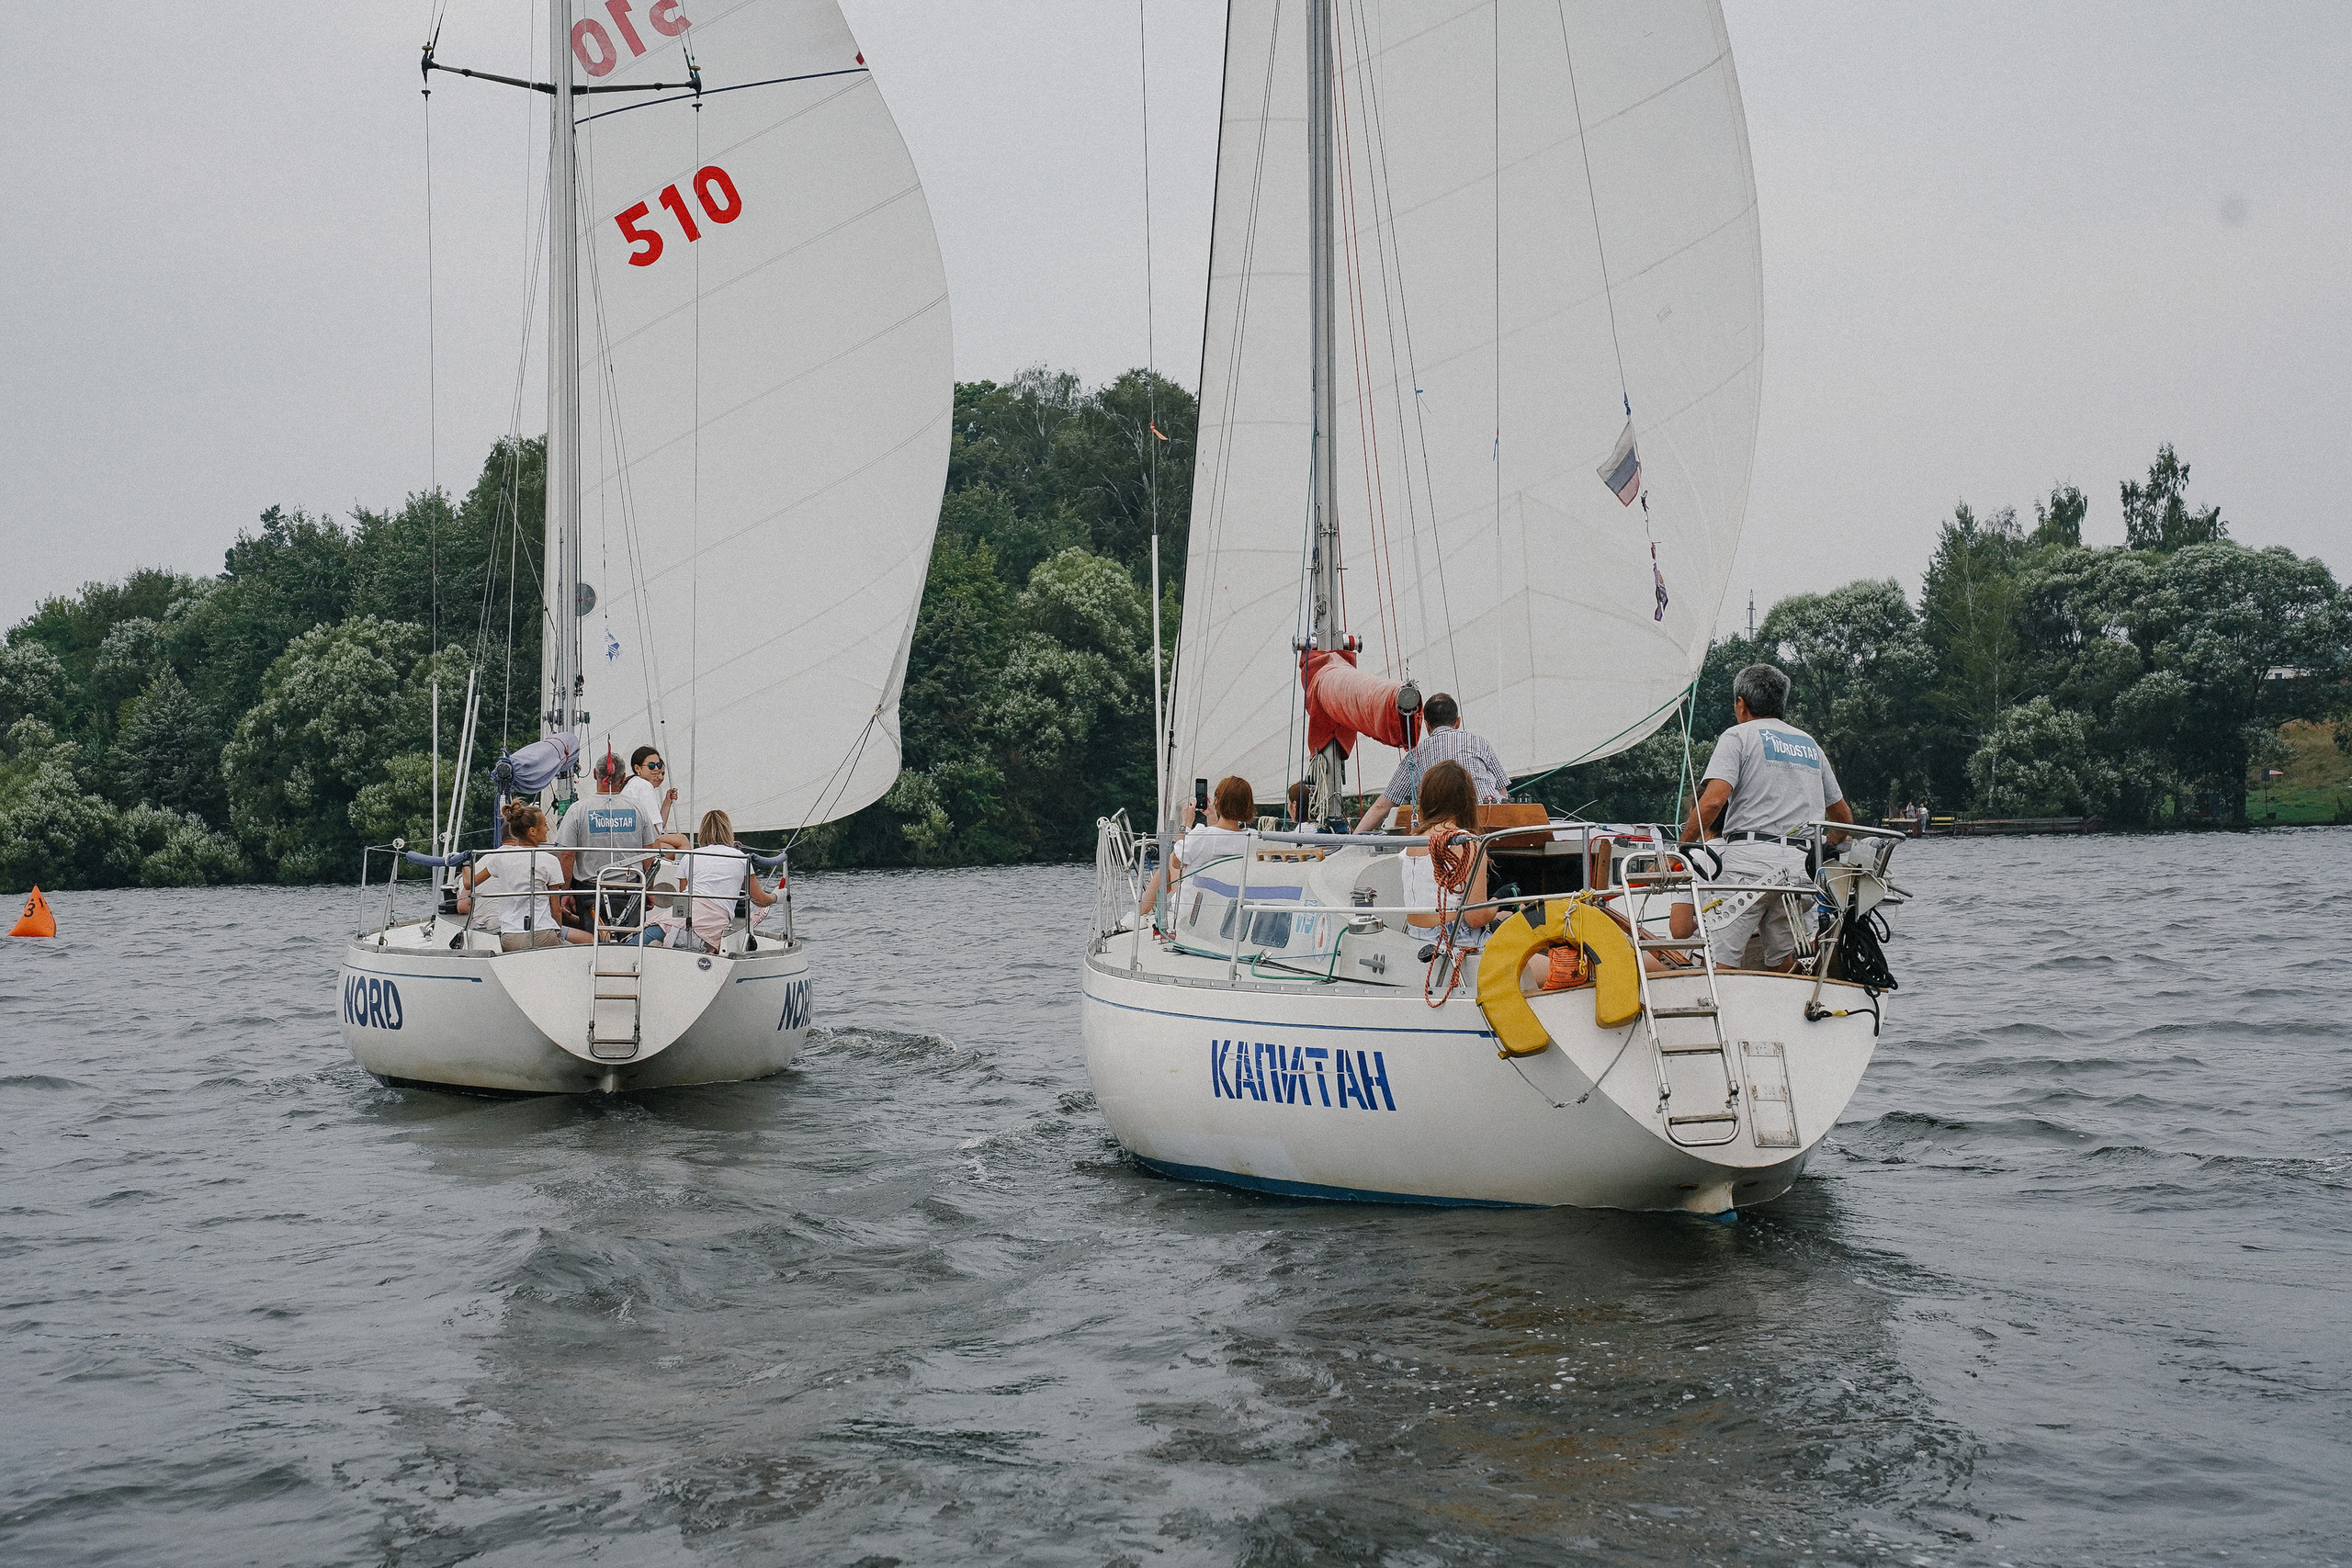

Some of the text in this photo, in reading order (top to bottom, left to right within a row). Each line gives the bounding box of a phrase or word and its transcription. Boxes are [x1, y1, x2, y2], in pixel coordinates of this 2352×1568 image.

[614, 165, 741, 266] 510
[1771, 738, 1819, 761] NORDSTAR
[595, 817, 633, 829] NORDSTAR
[24, 902, 36, 918] 3
[344, 974, 403, 1031] NORD
[1211, 1039, 1396, 1111] КАПИТАН
